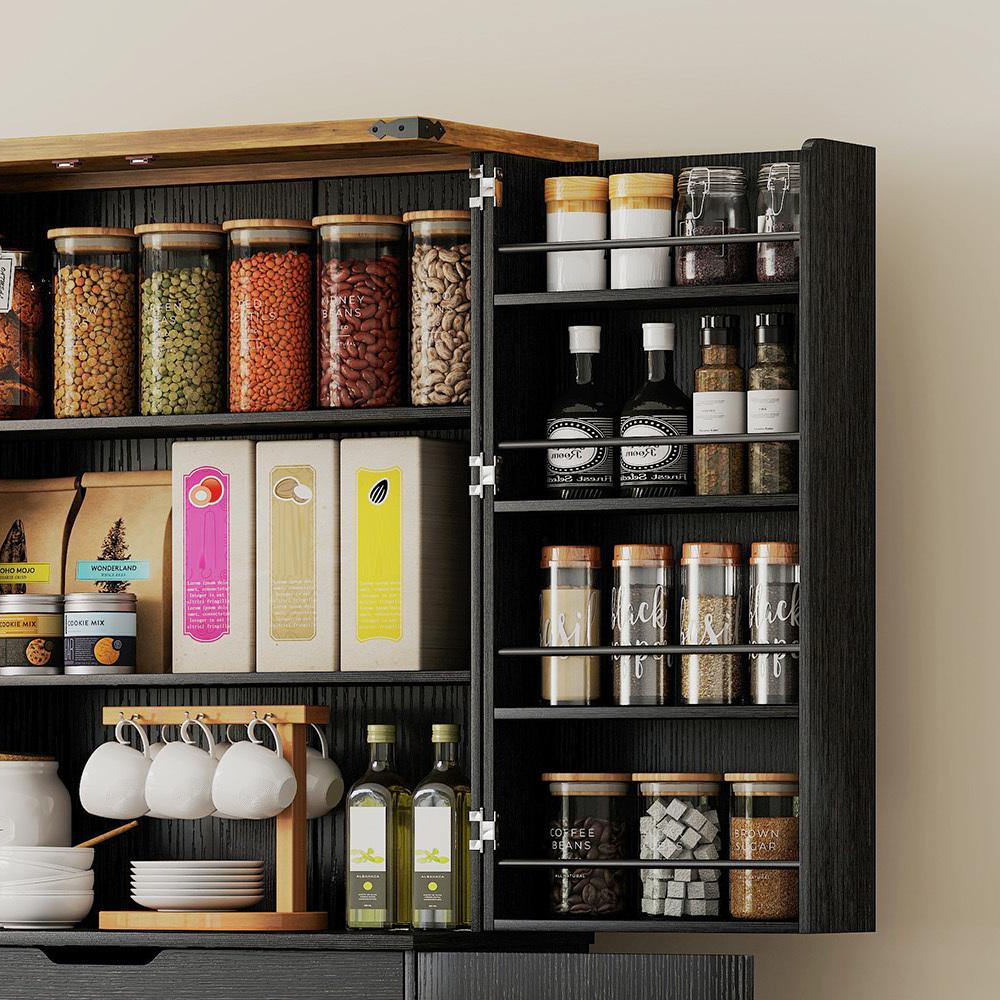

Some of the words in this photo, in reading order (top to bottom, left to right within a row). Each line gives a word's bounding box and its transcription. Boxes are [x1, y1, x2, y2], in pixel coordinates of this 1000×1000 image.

[322, 308, 361, 318] BANS
[91, 564, 137, 572] WONDERLAND
[22, 620, 37, 628] MIX
[550, 828, 595, 838] COFFEE
[734, 829, 780, 839] BROWN
[551, 840, 591, 850] BEANS
[735, 841, 777, 851] SUGAR
